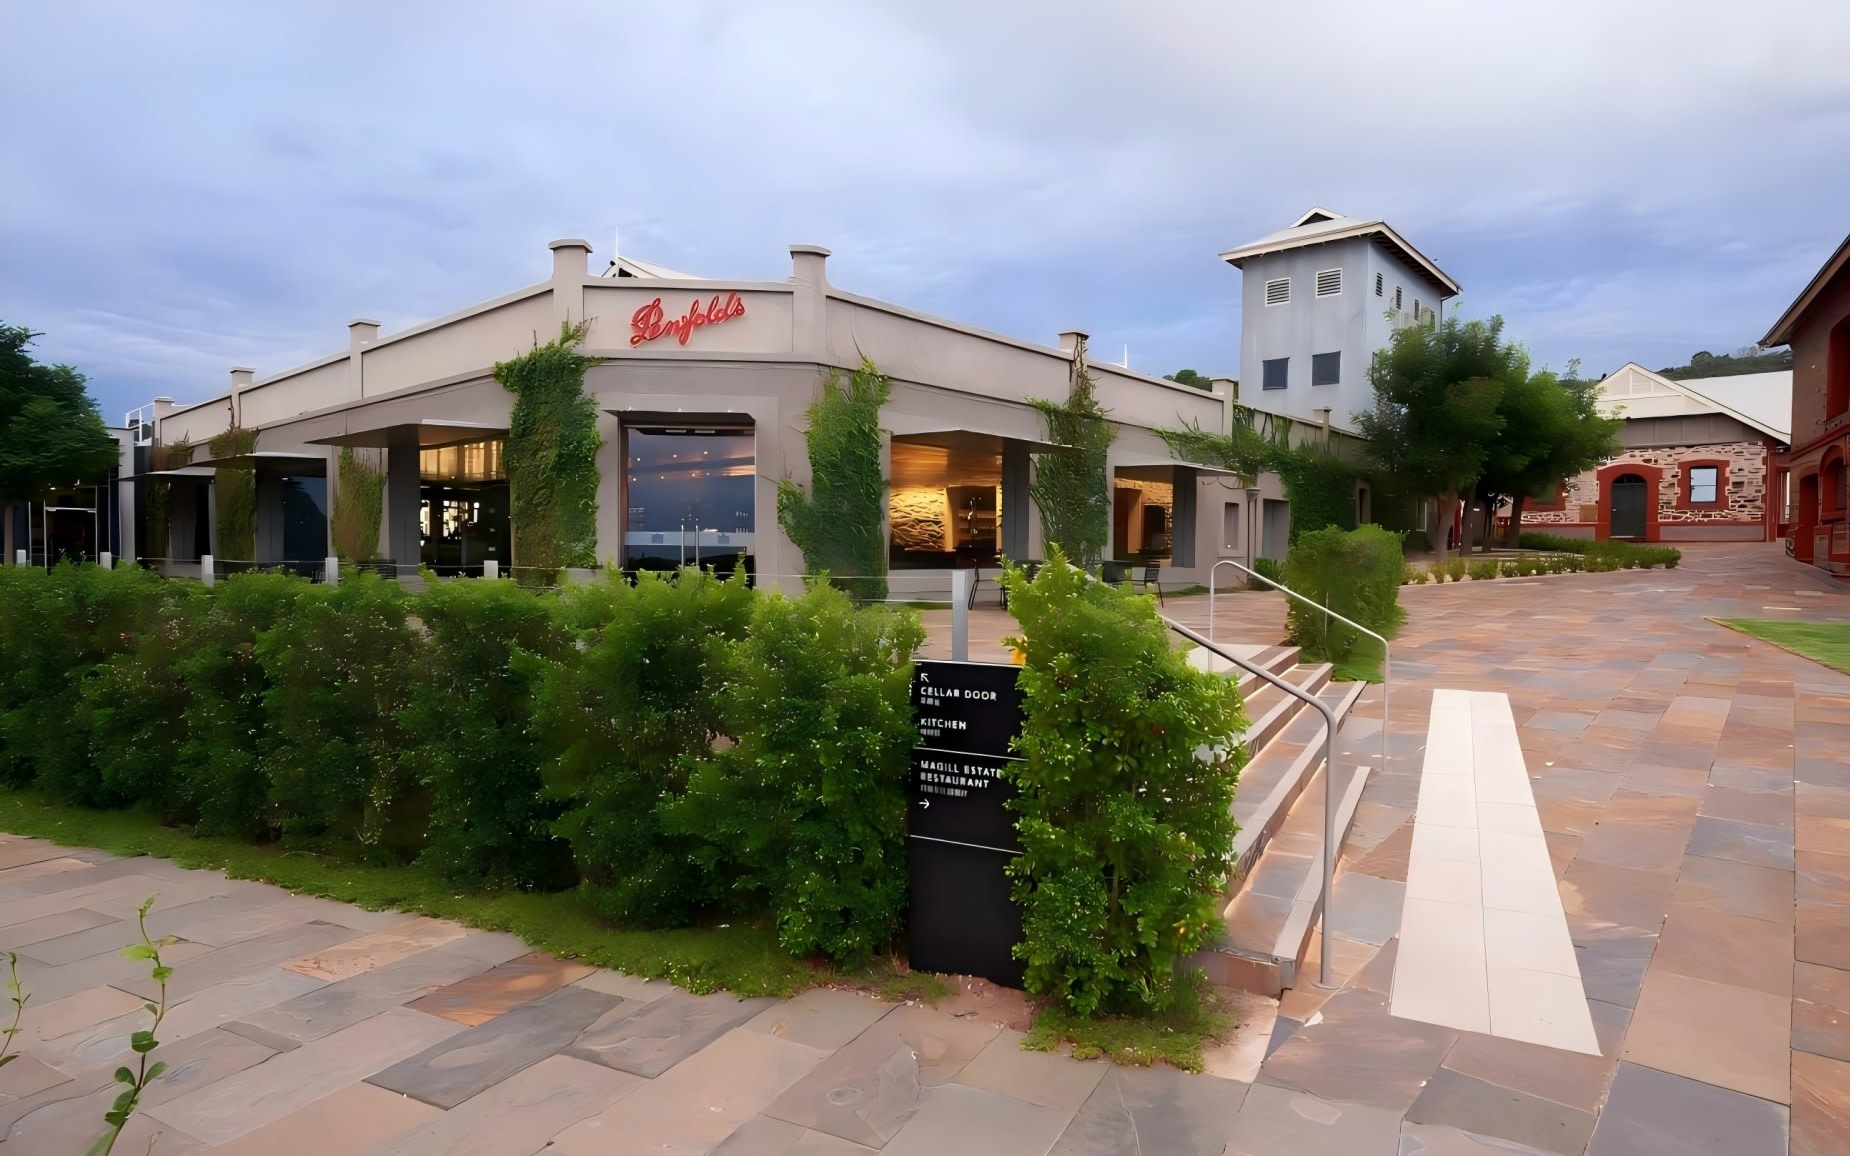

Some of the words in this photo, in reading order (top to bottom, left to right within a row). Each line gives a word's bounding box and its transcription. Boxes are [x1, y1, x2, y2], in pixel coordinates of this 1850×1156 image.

[630, 290, 745, 347] Penfolds
[920, 686, 960, 698] CELLAR
[964, 690, 997, 701] DOOR
[920, 718, 967, 730] KITCHEN
[920, 760, 959, 773] MAGILL
[920, 772, 989, 788] RESTAURANT
